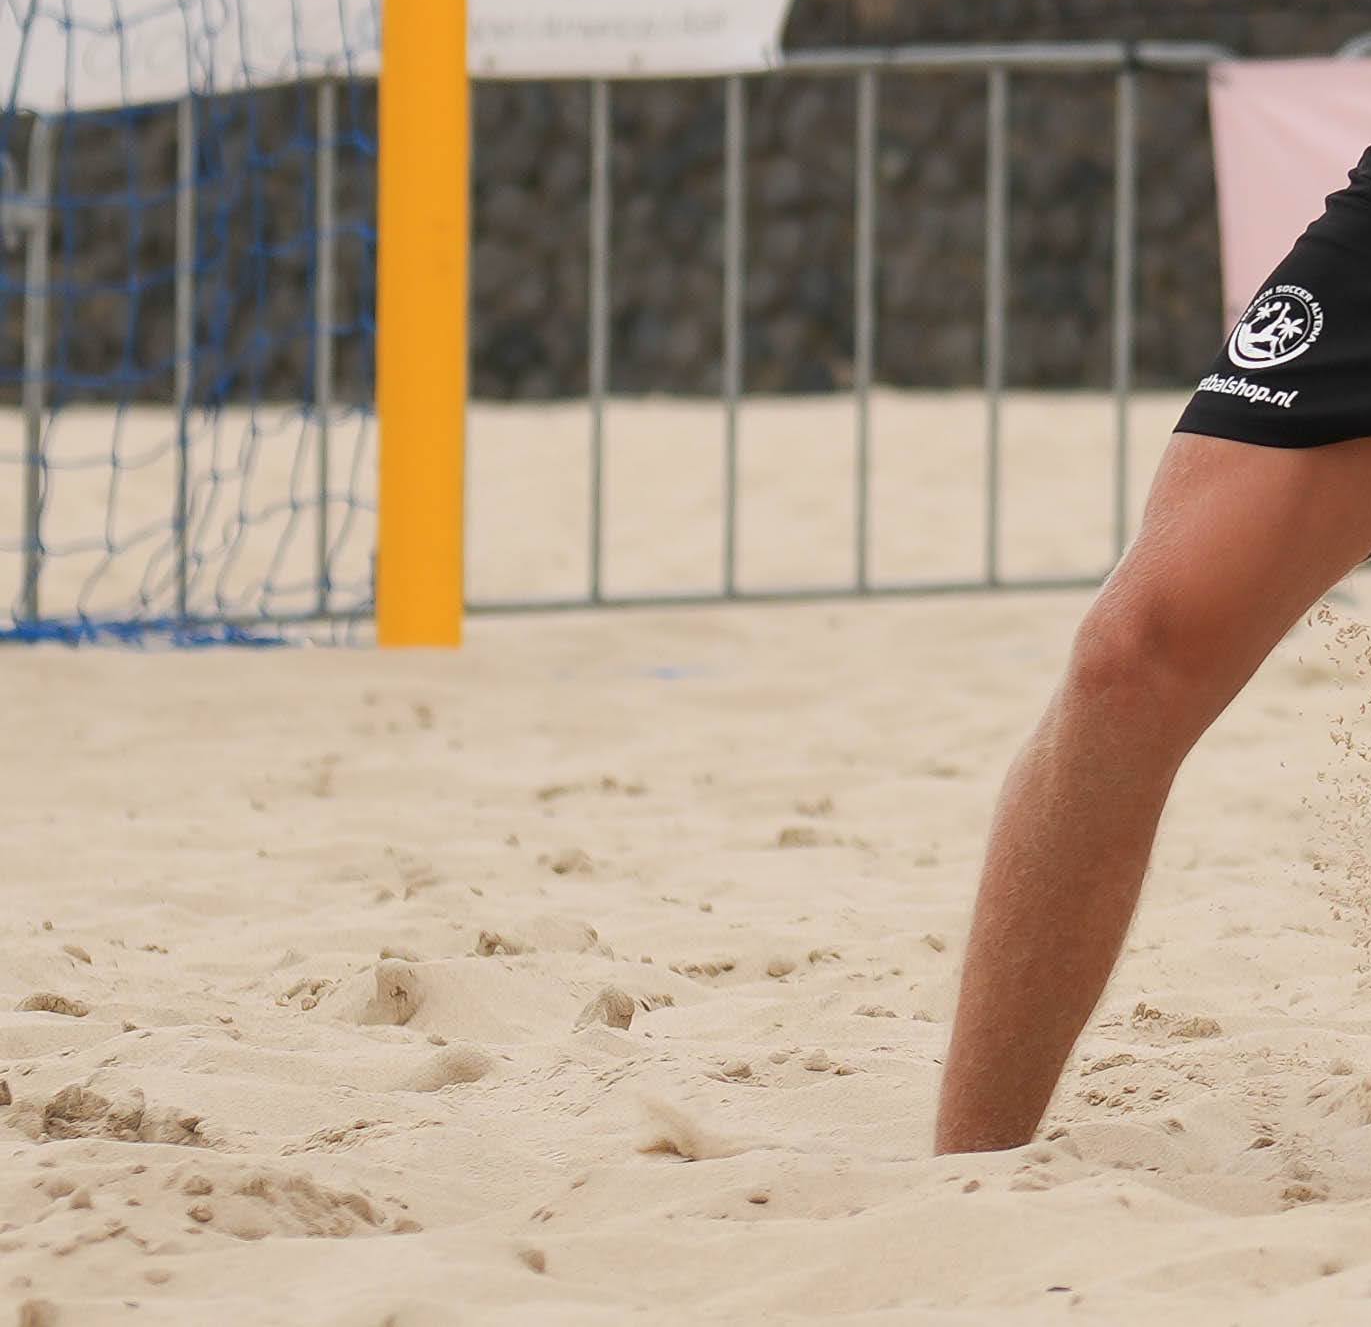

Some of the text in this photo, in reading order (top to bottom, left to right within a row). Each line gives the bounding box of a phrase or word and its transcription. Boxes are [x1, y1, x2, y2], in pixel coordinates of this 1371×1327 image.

[1275, 284, 1315, 304] SOCCER
[1306, 301, 1324, 343] ALTENA
[1198, 373, 1299, 409] etbalshop.nl
